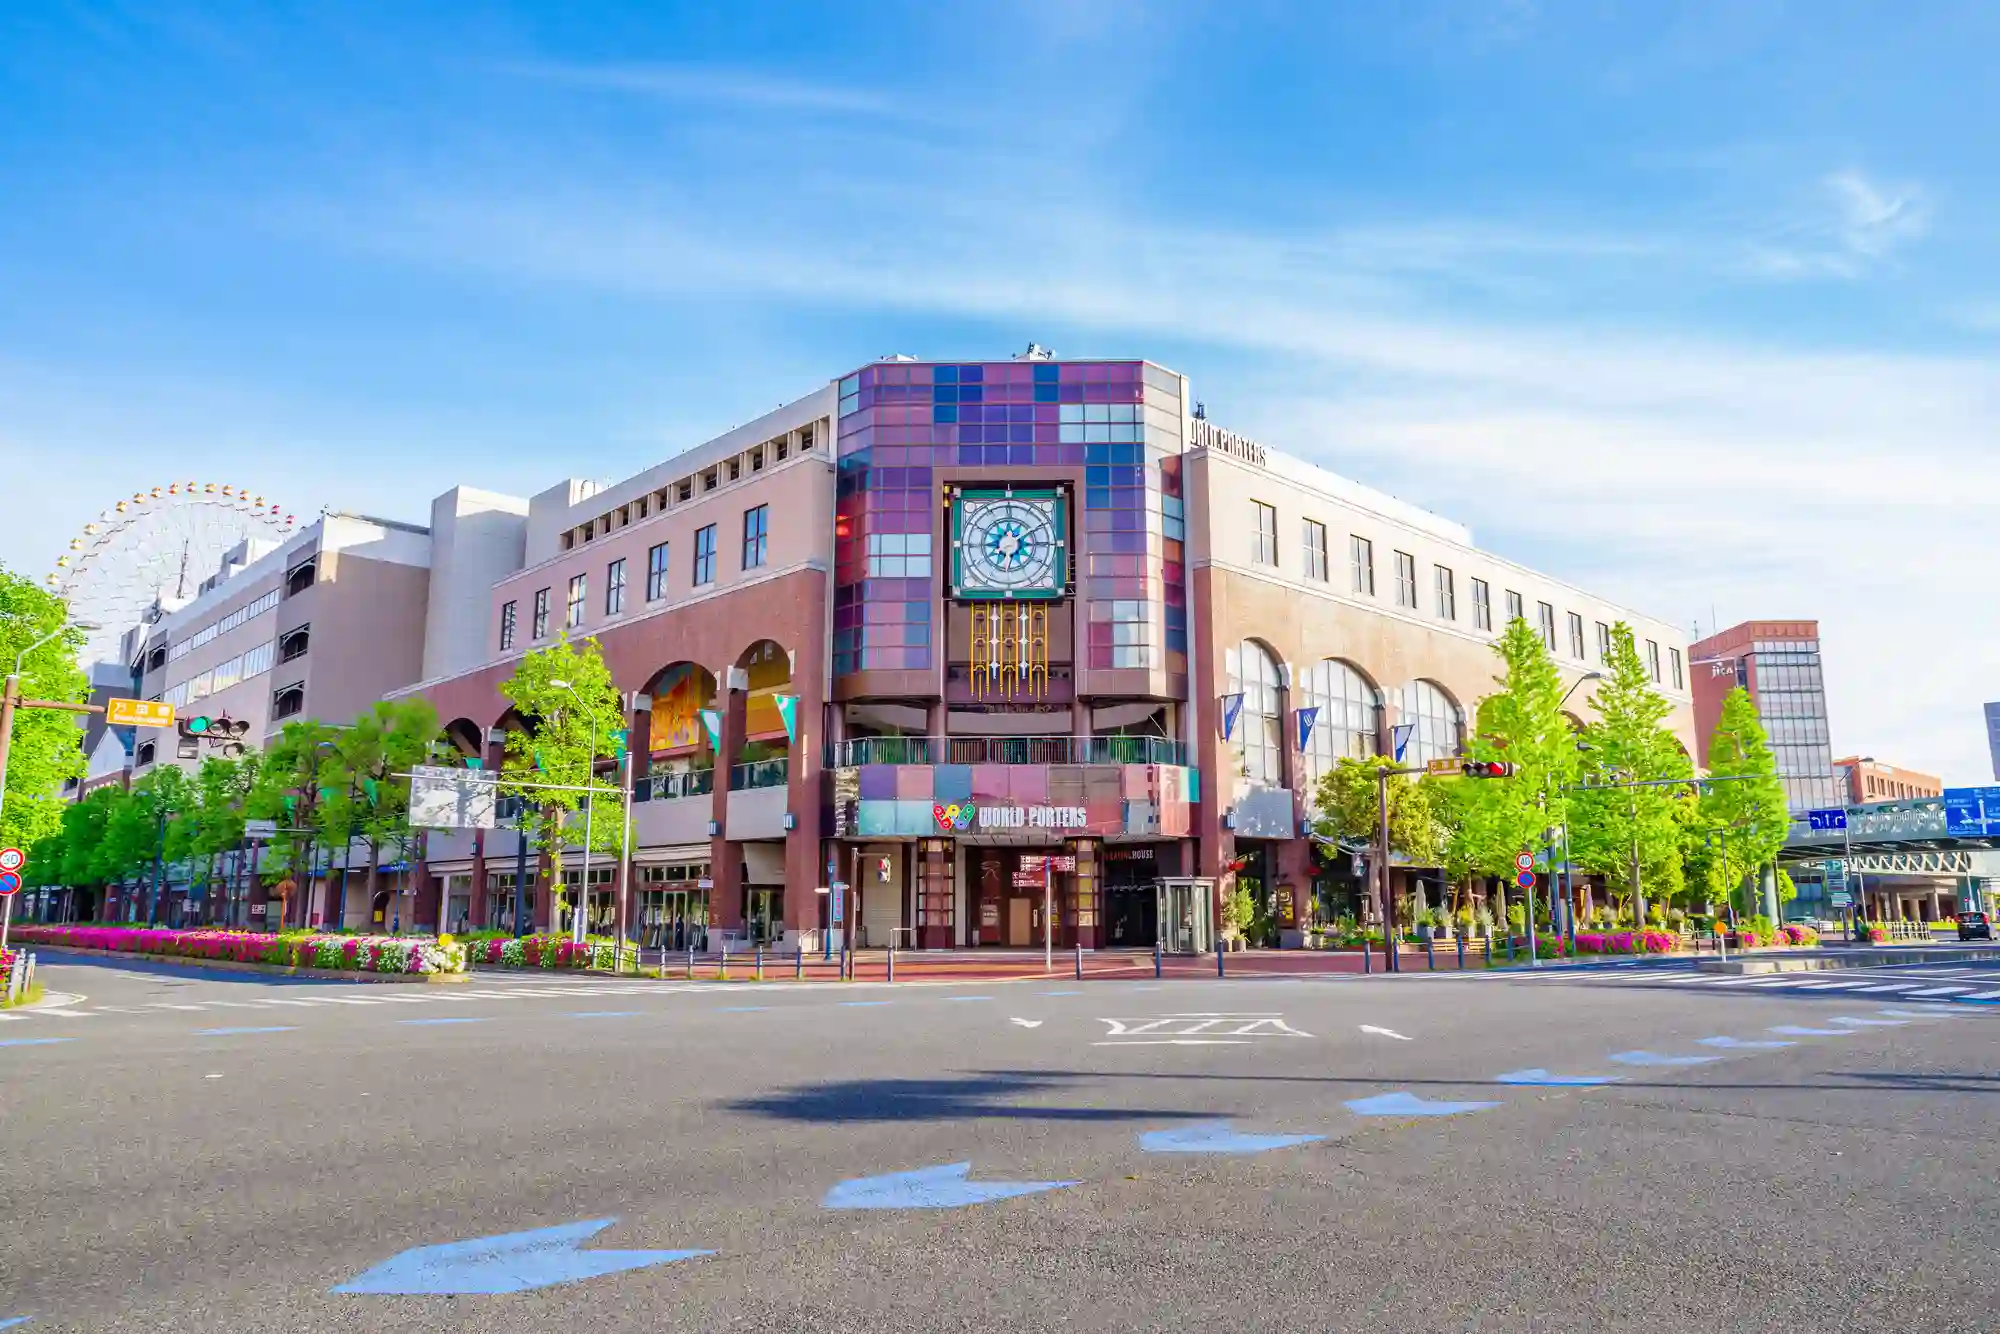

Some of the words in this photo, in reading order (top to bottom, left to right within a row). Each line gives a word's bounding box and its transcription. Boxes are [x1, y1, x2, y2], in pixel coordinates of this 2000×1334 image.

[979, 806, 1025, 828] WORLD
[1028, 806, 1087, 828] PORTERS
[3, 854, 19, 865] 30
[1132, 849, 1154, 860] HOUSE
[1520, 856, 1531, 865] 40
